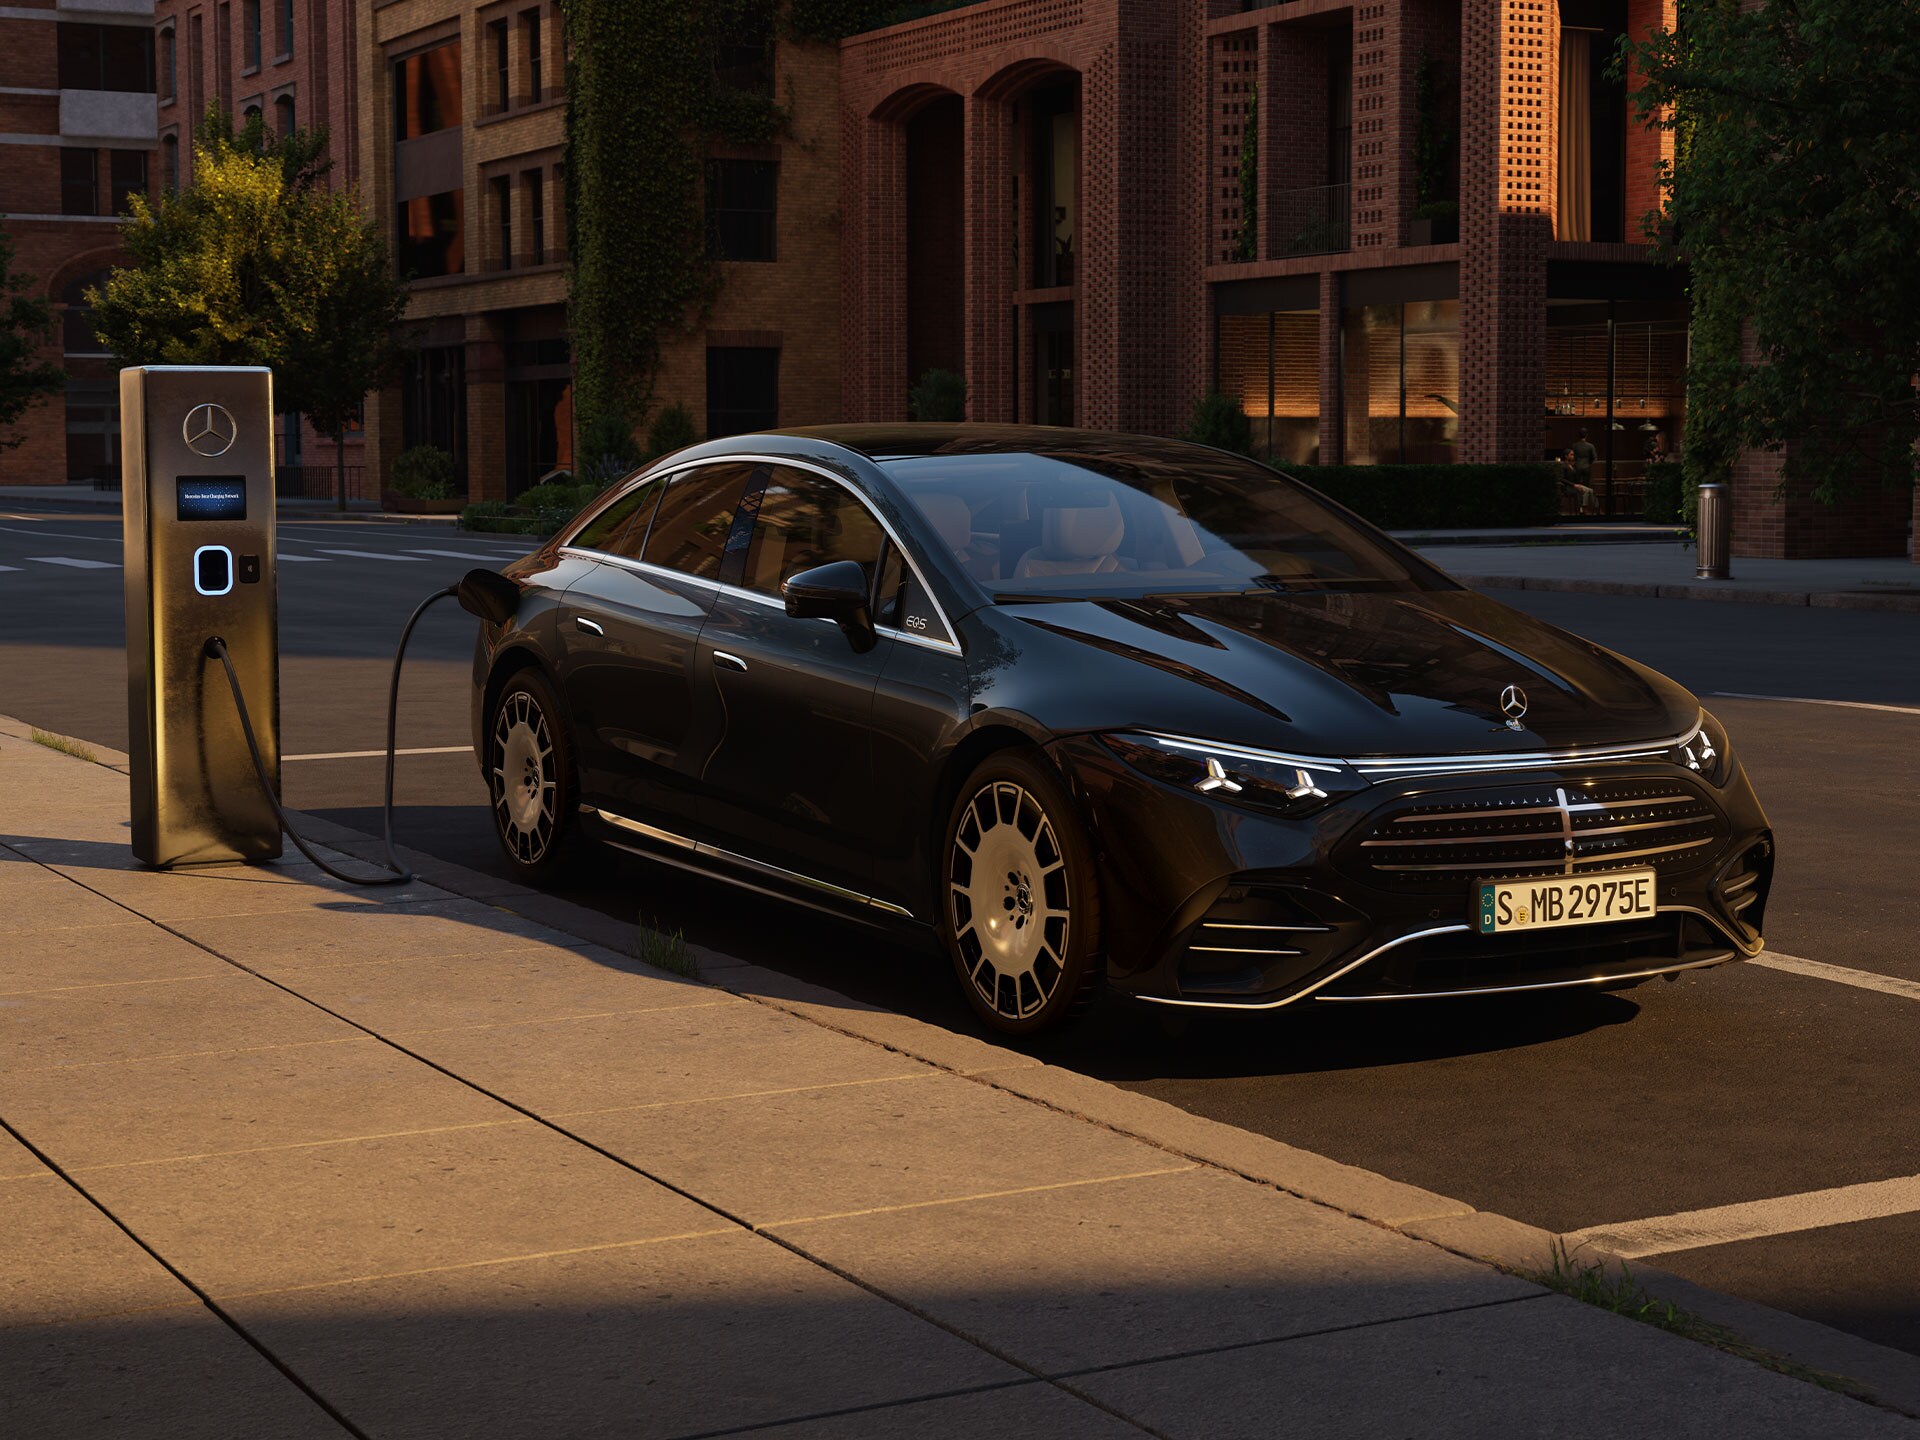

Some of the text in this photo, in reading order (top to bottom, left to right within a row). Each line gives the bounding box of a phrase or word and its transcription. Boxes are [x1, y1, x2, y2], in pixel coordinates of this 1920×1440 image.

[906, 615, 928, 630] EQS
[1497, 890, 1513, 926] S
[1484, 914, 1492, 925] D
